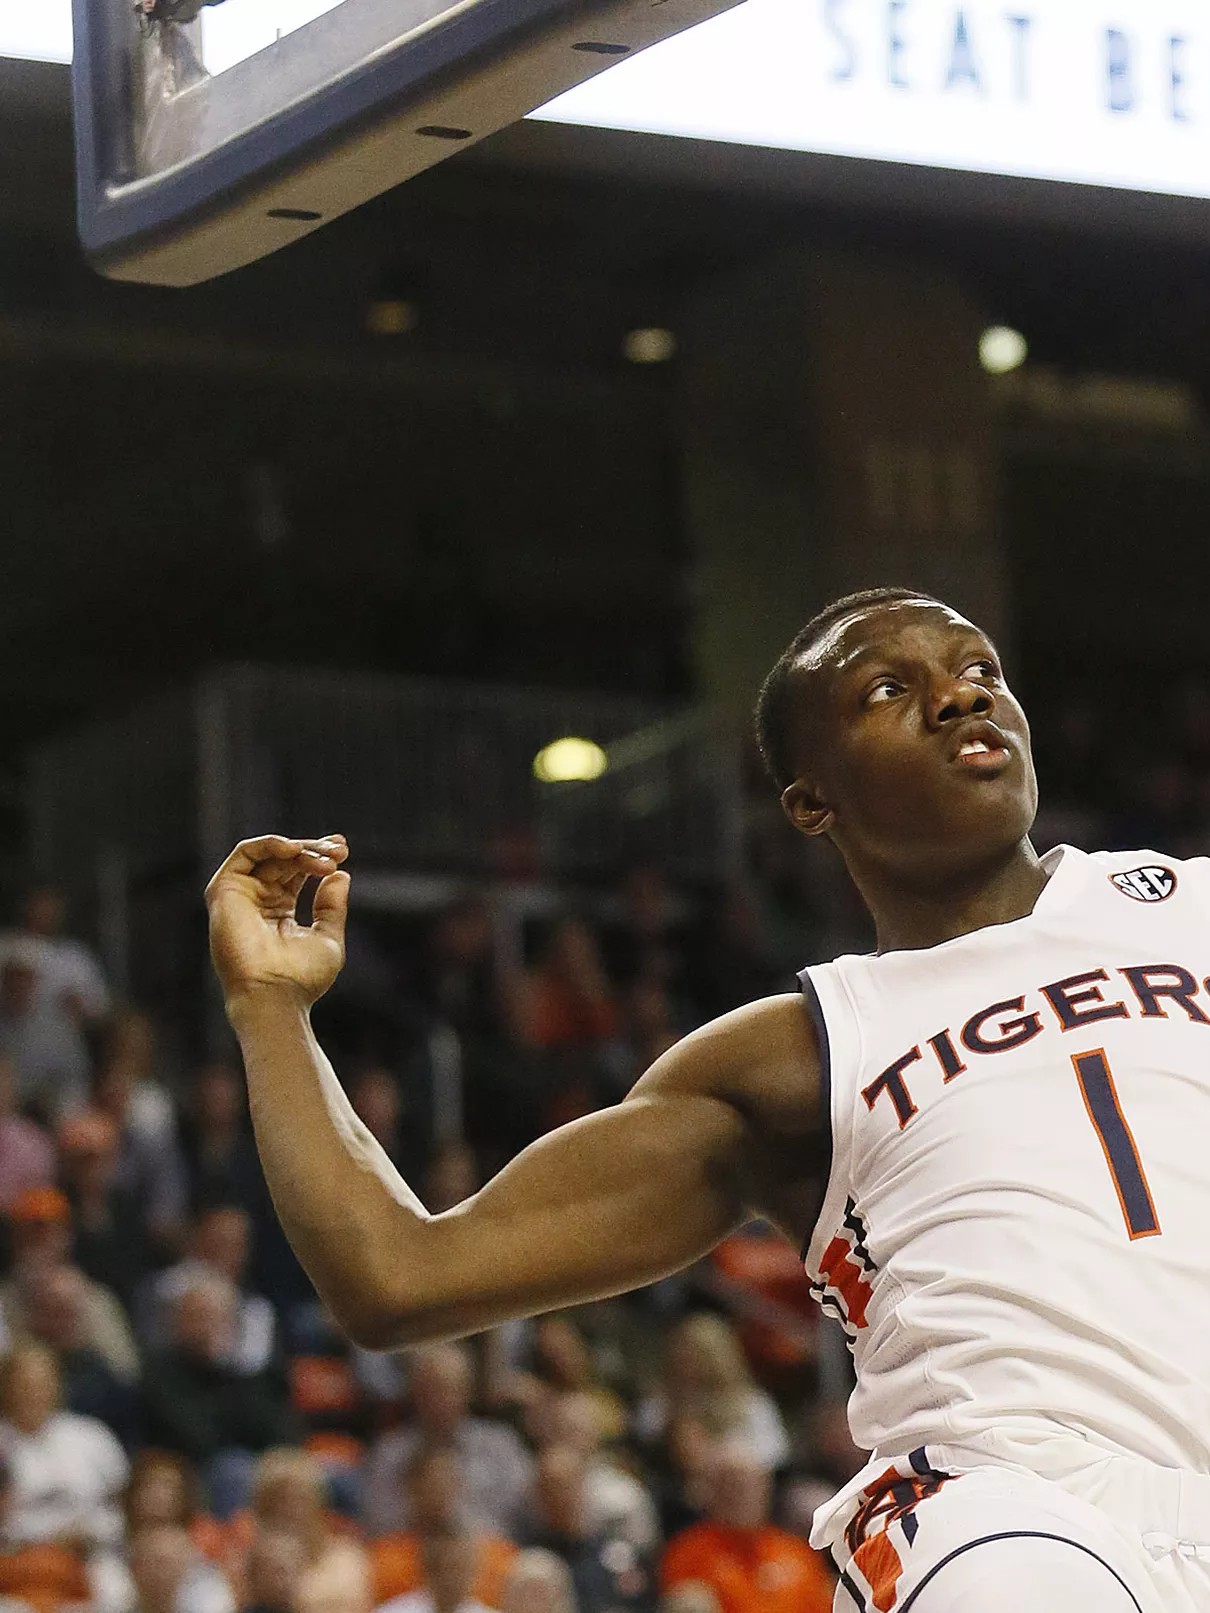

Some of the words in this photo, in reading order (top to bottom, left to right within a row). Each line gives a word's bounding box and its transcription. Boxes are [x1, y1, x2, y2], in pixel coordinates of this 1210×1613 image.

[823, 0, 1034, 103] SEAT
[1112, 866, 1174, 901] SEC
[1070, 1046, 1162, 1241] 1
